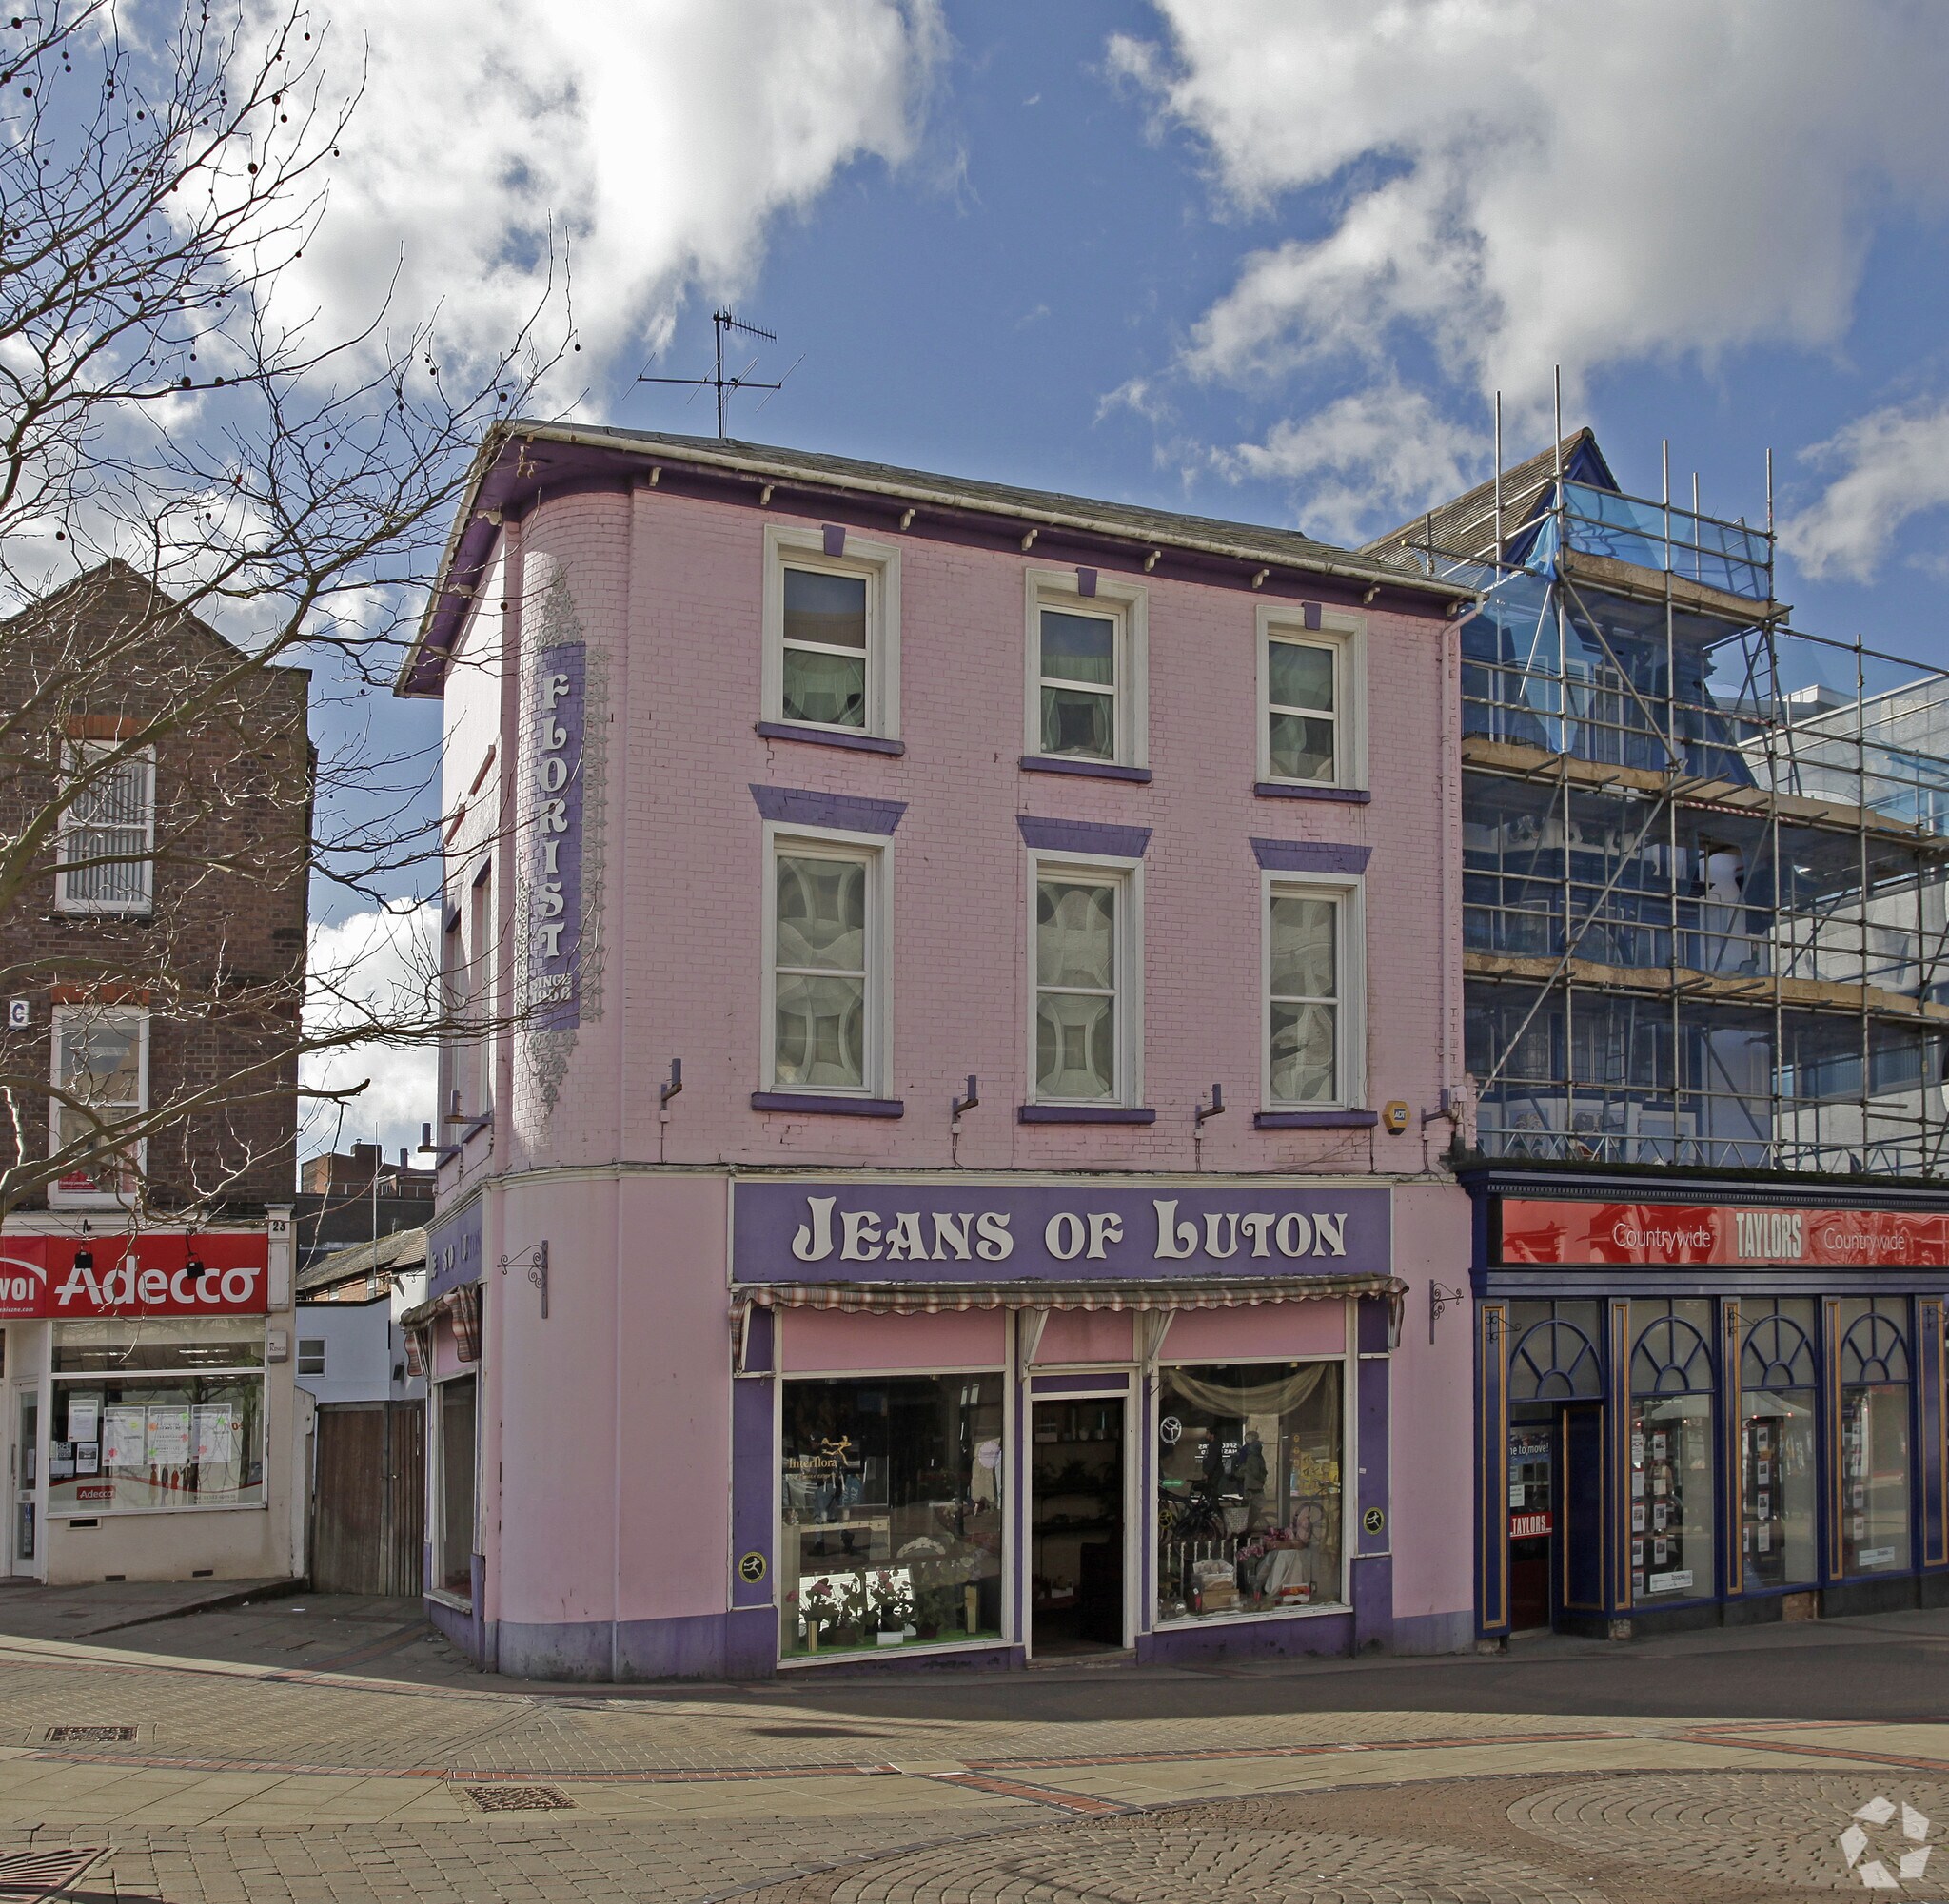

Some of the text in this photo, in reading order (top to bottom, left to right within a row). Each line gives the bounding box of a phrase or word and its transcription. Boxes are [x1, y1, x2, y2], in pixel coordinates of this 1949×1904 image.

[537, 673, 570, 958] FLORIST
[12, 1004, 25, 1023] C
[272, 1221, 285, 1231] 23
[792, 1196, 1348, 1261] JEANS OF LUTON
[1613, 1213, 1905, 1258] Countrywide TAYLORS Countrywide
[54, 1256, 262, 1305] Adecco
[789, 1456, 837, 1469] Interflora
[80, 1489, 114, 1499] Adecco
[1511, 1514, 1546, 1535] TAYLORS
